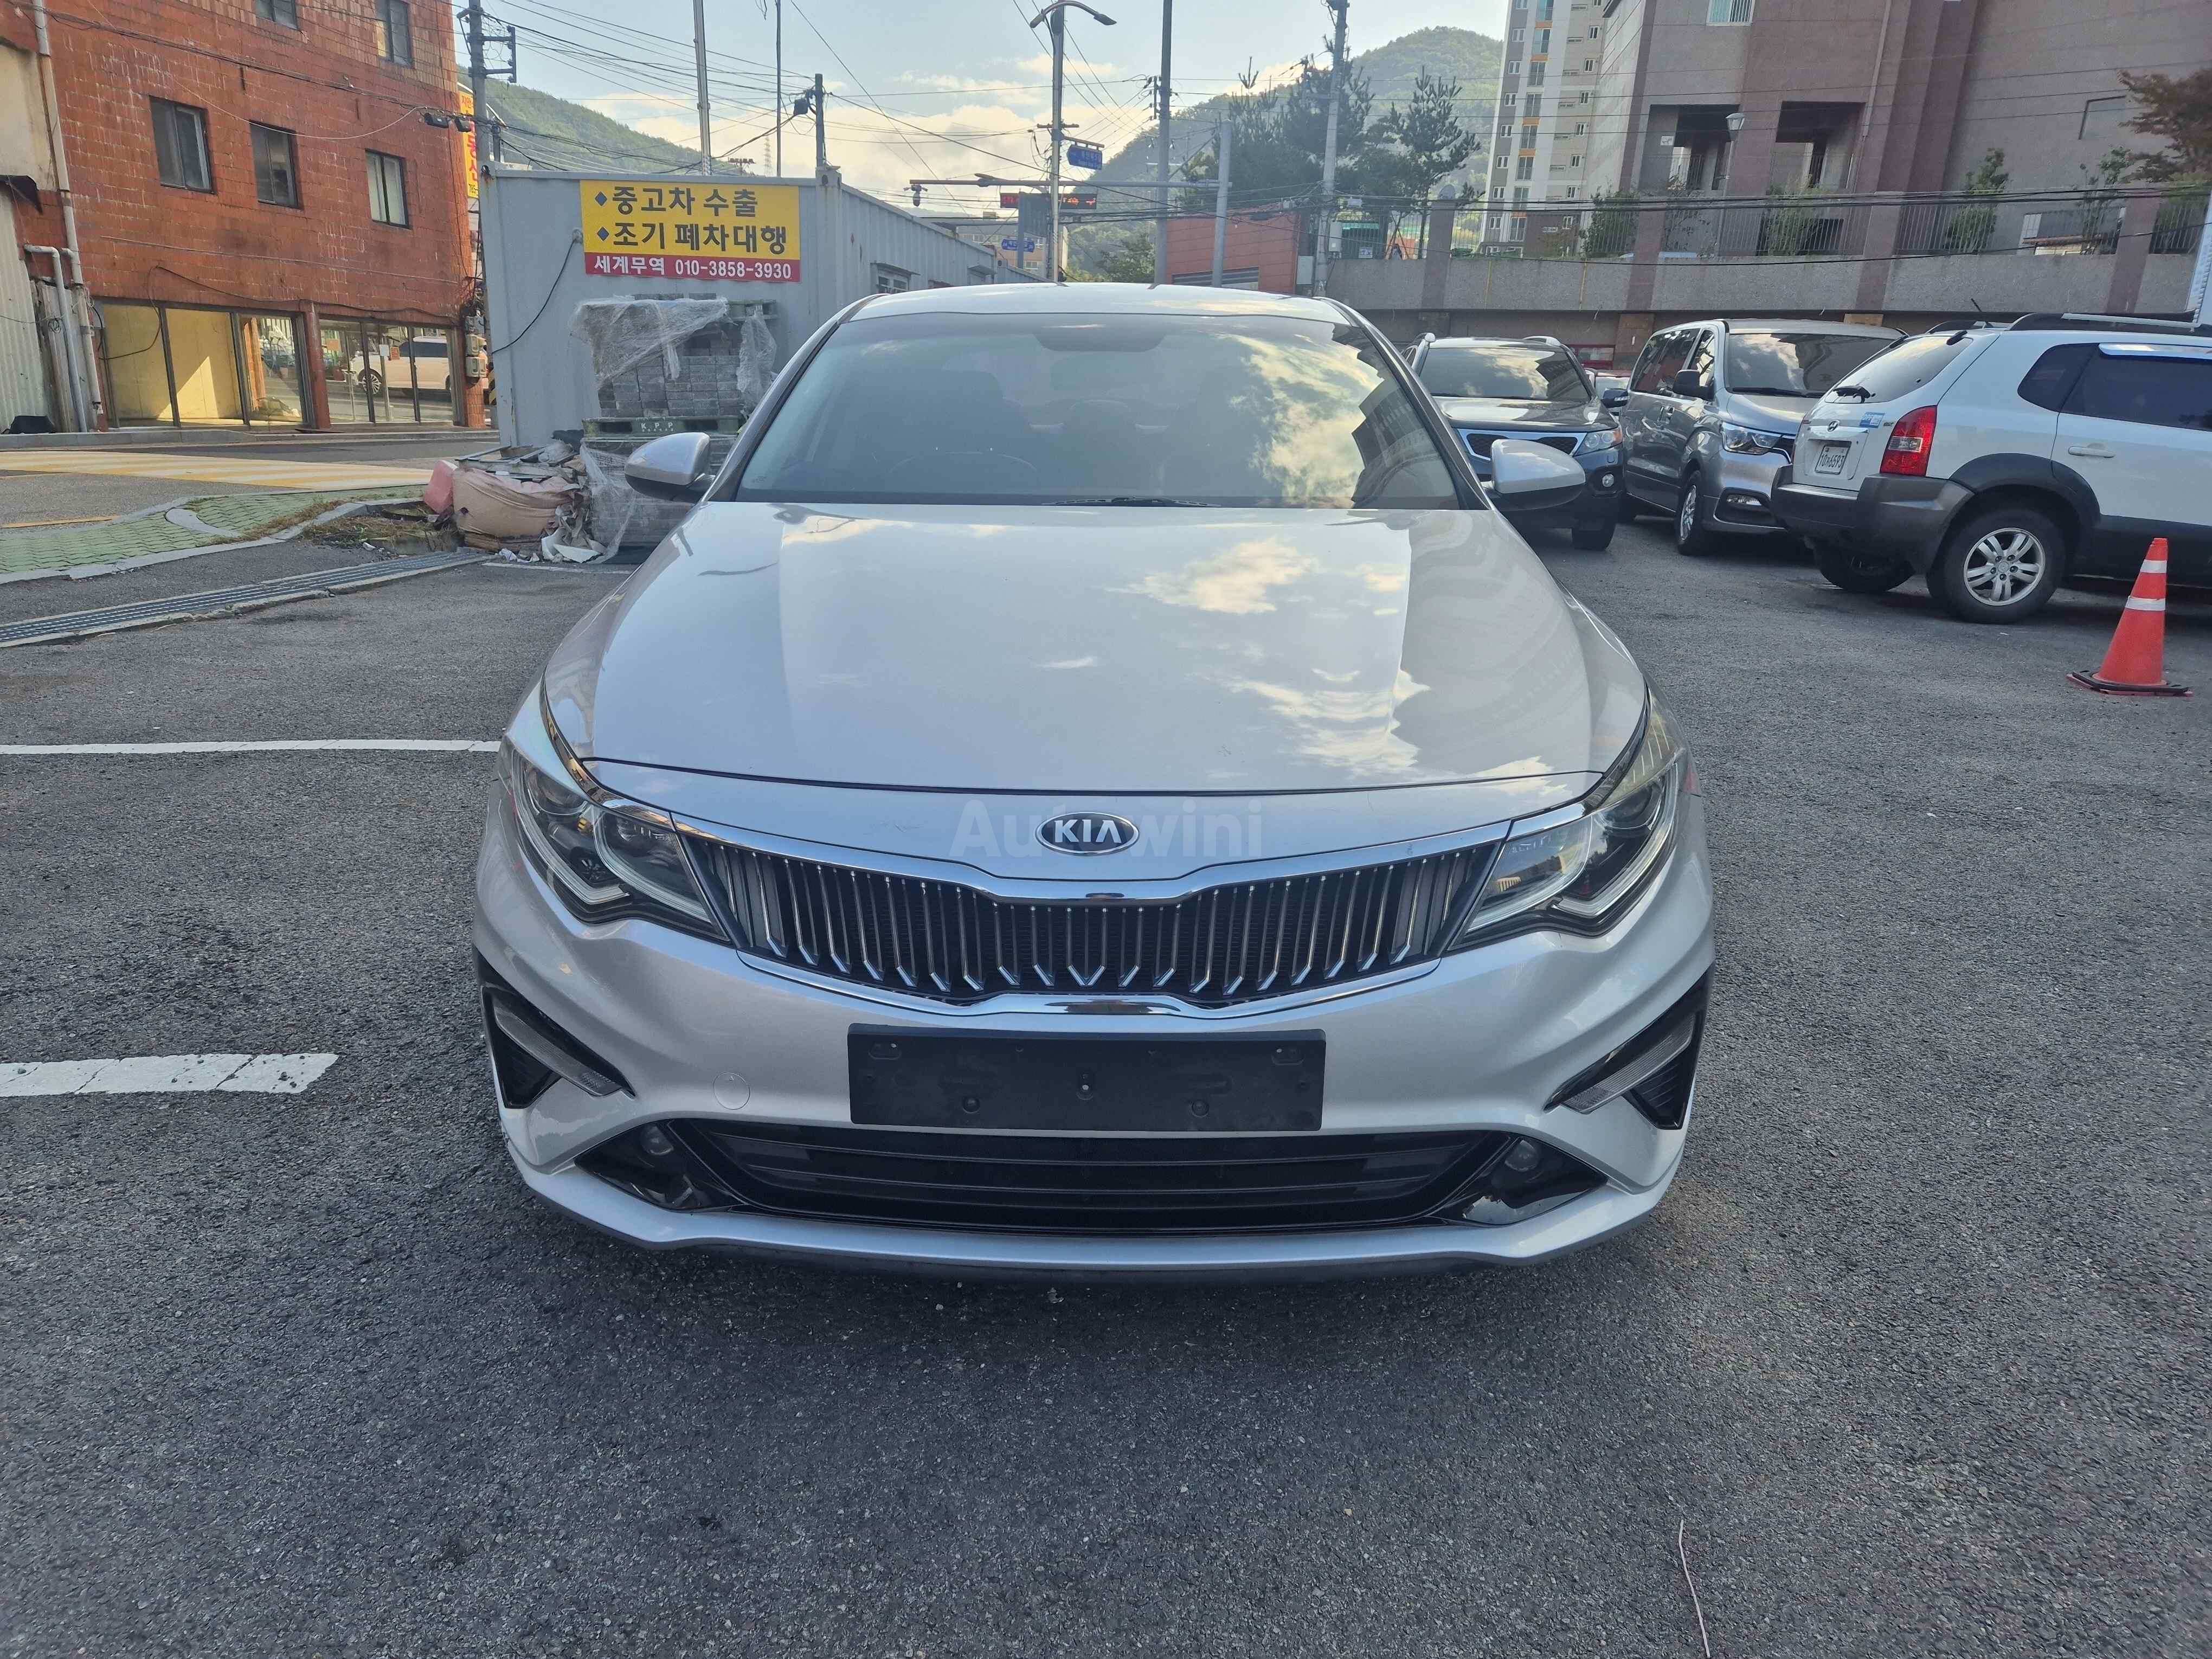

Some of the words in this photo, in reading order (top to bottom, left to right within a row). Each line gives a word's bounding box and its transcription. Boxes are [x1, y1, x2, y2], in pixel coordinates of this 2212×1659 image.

[612, 187, 695, 215] 중고차
[703, 189, 758, 217] 수출
[613, 222, 665, 249] 조기
[674, 223, 786, 254] 폐차대행
[594, 255, 665, 275] 세계무역
[675, 260, 791, 279] 010-3858-3930
[1054, 819, 1122, 844] KIA
